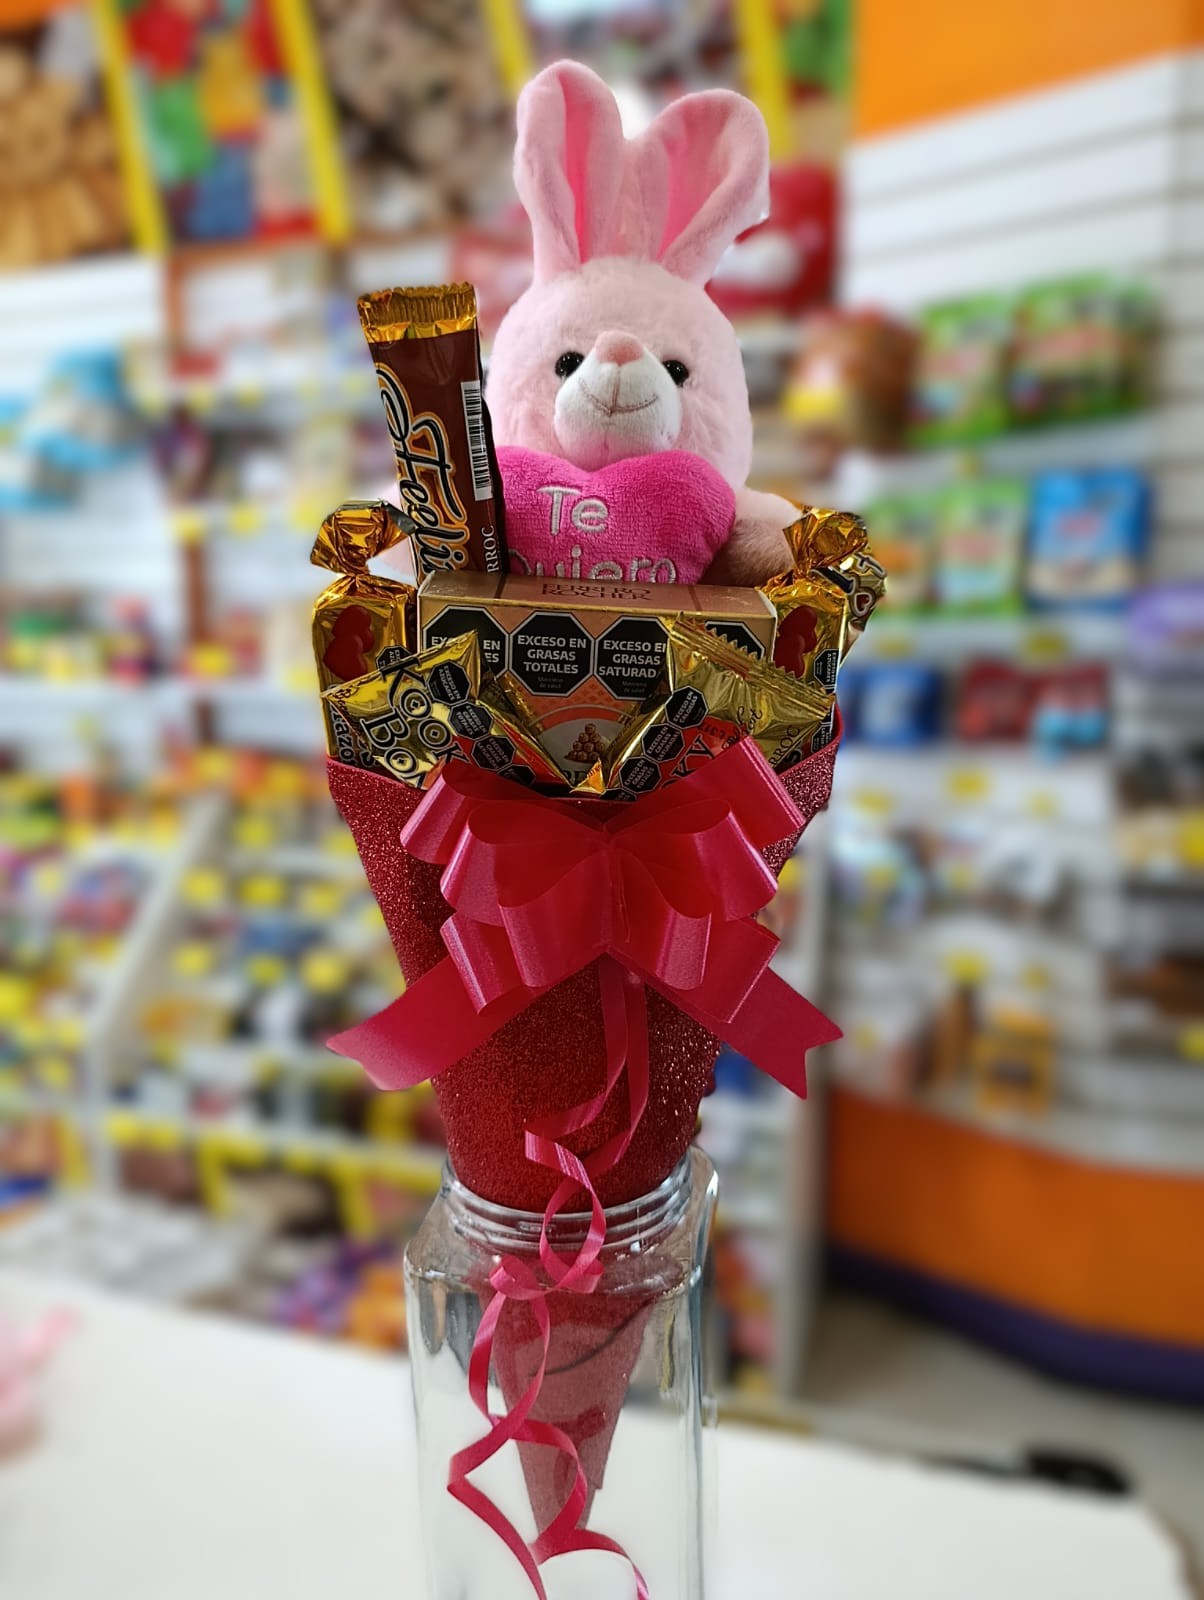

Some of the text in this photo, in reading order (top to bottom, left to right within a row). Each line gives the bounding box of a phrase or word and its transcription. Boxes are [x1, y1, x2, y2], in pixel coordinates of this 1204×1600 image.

[536, 485, 609, 536] Te
[541, 589, 656, 601] ROCHER
[542, 583, 651, 595] FERRERO
[517, 635, 588, 649] EXCESO EN
[603, 640, 654, 652] EXCESO
[527, 649, 576, 661] GRASAS
[612, 653, 661, 665] GRASAS
[523, 661, 580, 674] TOTALES
[599, 665, 658, 679] SATURAD
[380, 657, 470, 763] KOOK
